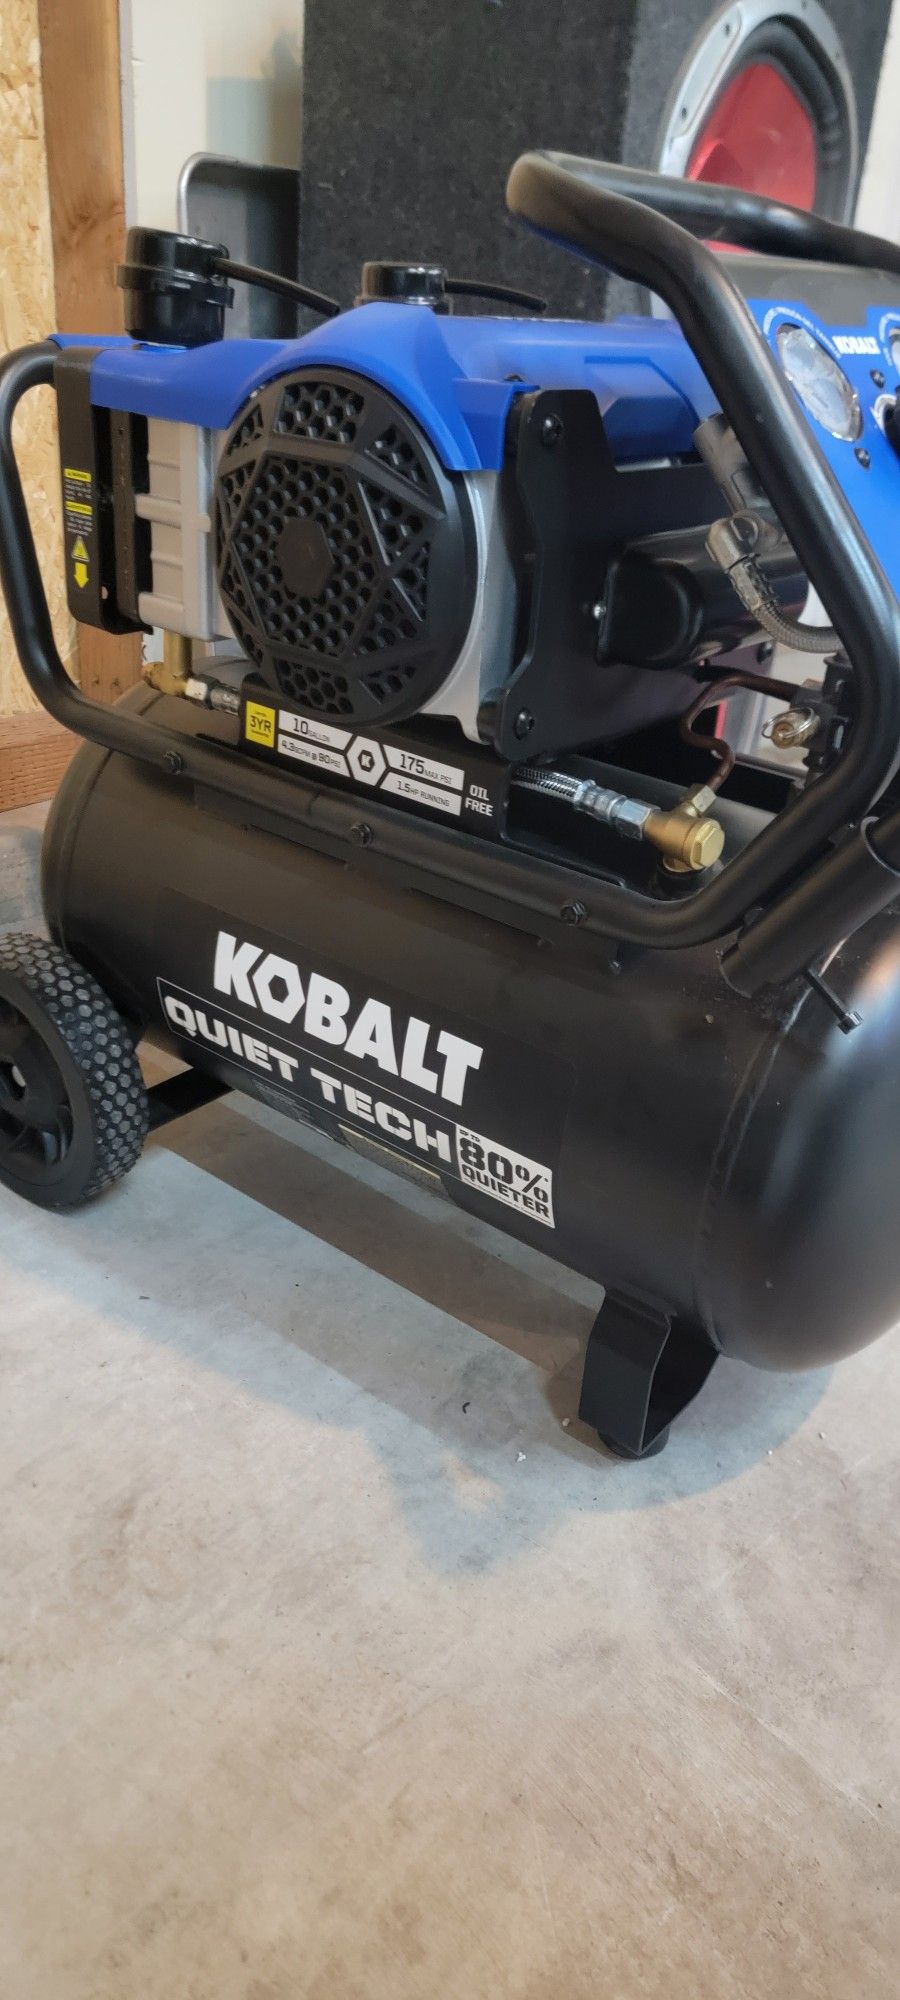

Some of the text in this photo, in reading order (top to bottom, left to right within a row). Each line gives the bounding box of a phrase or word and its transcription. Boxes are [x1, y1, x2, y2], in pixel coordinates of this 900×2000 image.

[250, 715, 272, 732] 3YR
[420, 790, 450, 807] RUNNING
[469, 784, 490, 801] OIL
[465, 797, 494, 817] FREE
[213, 930, 484, 1107] KOBALT
[164, 995, 299, 1083] QUIET
[310, 1067, 452, 1163] TECH
[461, 1163, 550, 1219] QUIETER
